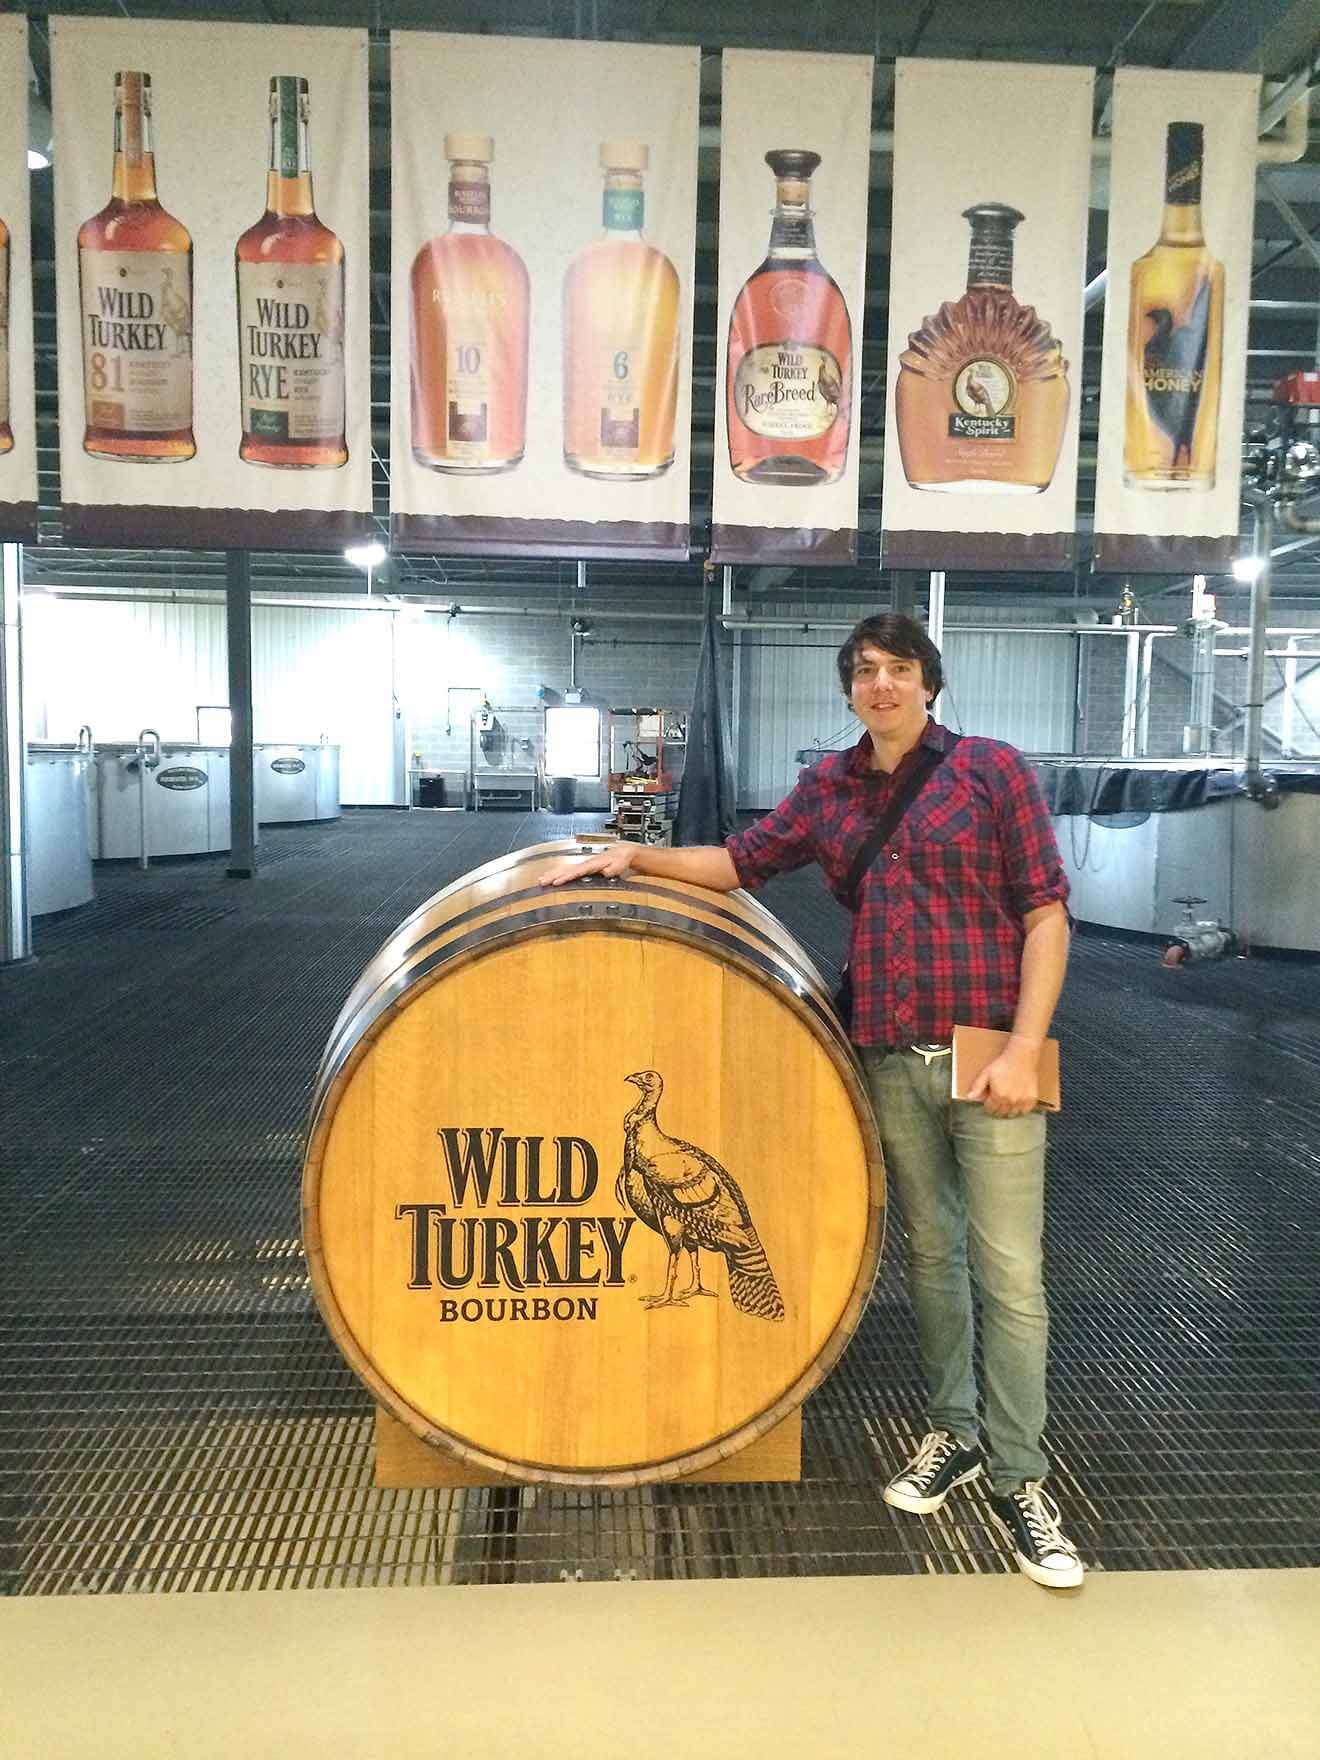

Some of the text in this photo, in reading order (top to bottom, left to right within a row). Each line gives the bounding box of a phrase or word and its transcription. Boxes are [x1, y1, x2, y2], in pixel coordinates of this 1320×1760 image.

[97, 286, 154, 319] WILD
[256, 298, 310, 329] WILD
[87, 314, 167, 351] TURKEY
[247, 325, 321, 361] TURKEY
[91, 352, 125, 392] 81
[456, 345, 480, 374] 10
[613, 351, 629, 380] 6
[771, 364, 808, 380] TURKEY
[777, 352, 803, 366] WILD
[249, 363, 290, 400] RYE
[1143, 378, 1203, 392] HONEY
[955, 416, 1009, 430] Kentucky
[965, 426, 999, 438] Spirit
[437, 1127, 599, 1208] WILD
[395, 1203, 637, 1292] TURKEY
[439, 1297, 599, 1323] BOURBON
